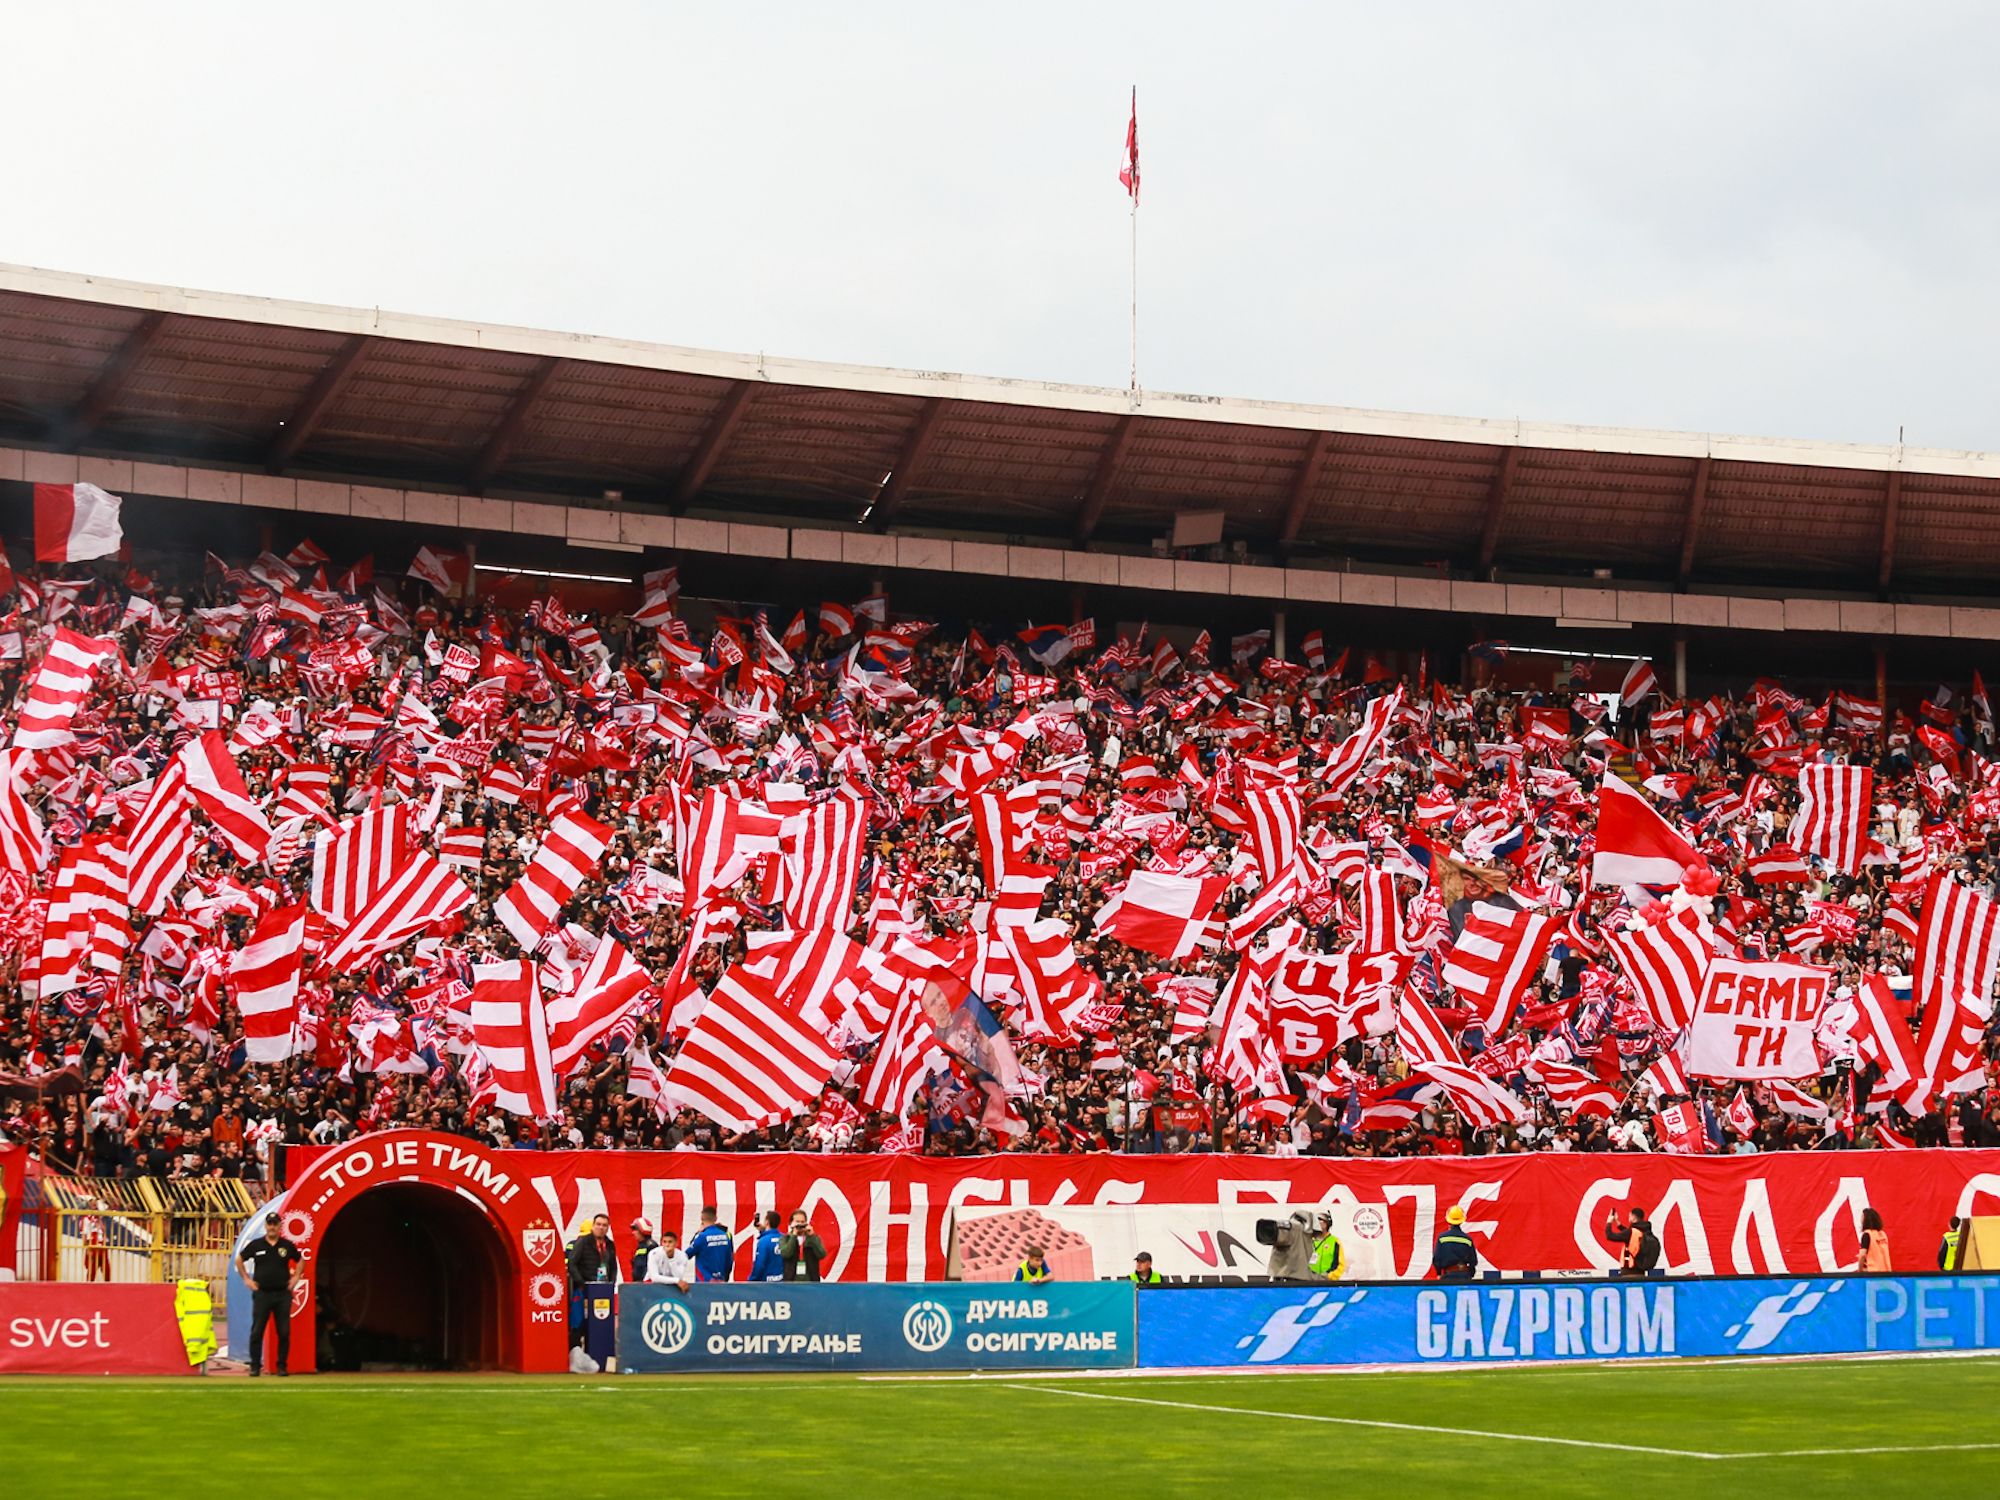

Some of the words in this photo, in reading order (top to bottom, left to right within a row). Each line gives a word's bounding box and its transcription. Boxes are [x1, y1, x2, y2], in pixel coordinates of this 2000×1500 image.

[381, 1140, 419, 1169] ЈЕ
[425, 1141, 521, 1205] ТИМ!
[706, 1300, 791, 1326] ДУНАВ
[966, 1299, 1048, 1325] ДУНАВ
[1416, 1284, 1676, 1358] GAZPROM
[1865, 1277, 2000, 1348] PET
[9, 1310, 110, 1350] svet
[706, 1333, 863, 1355] ОСИГУРАЊЕ
[966, 1331, 1117, 1353] ОСИГУРАЊЕ
